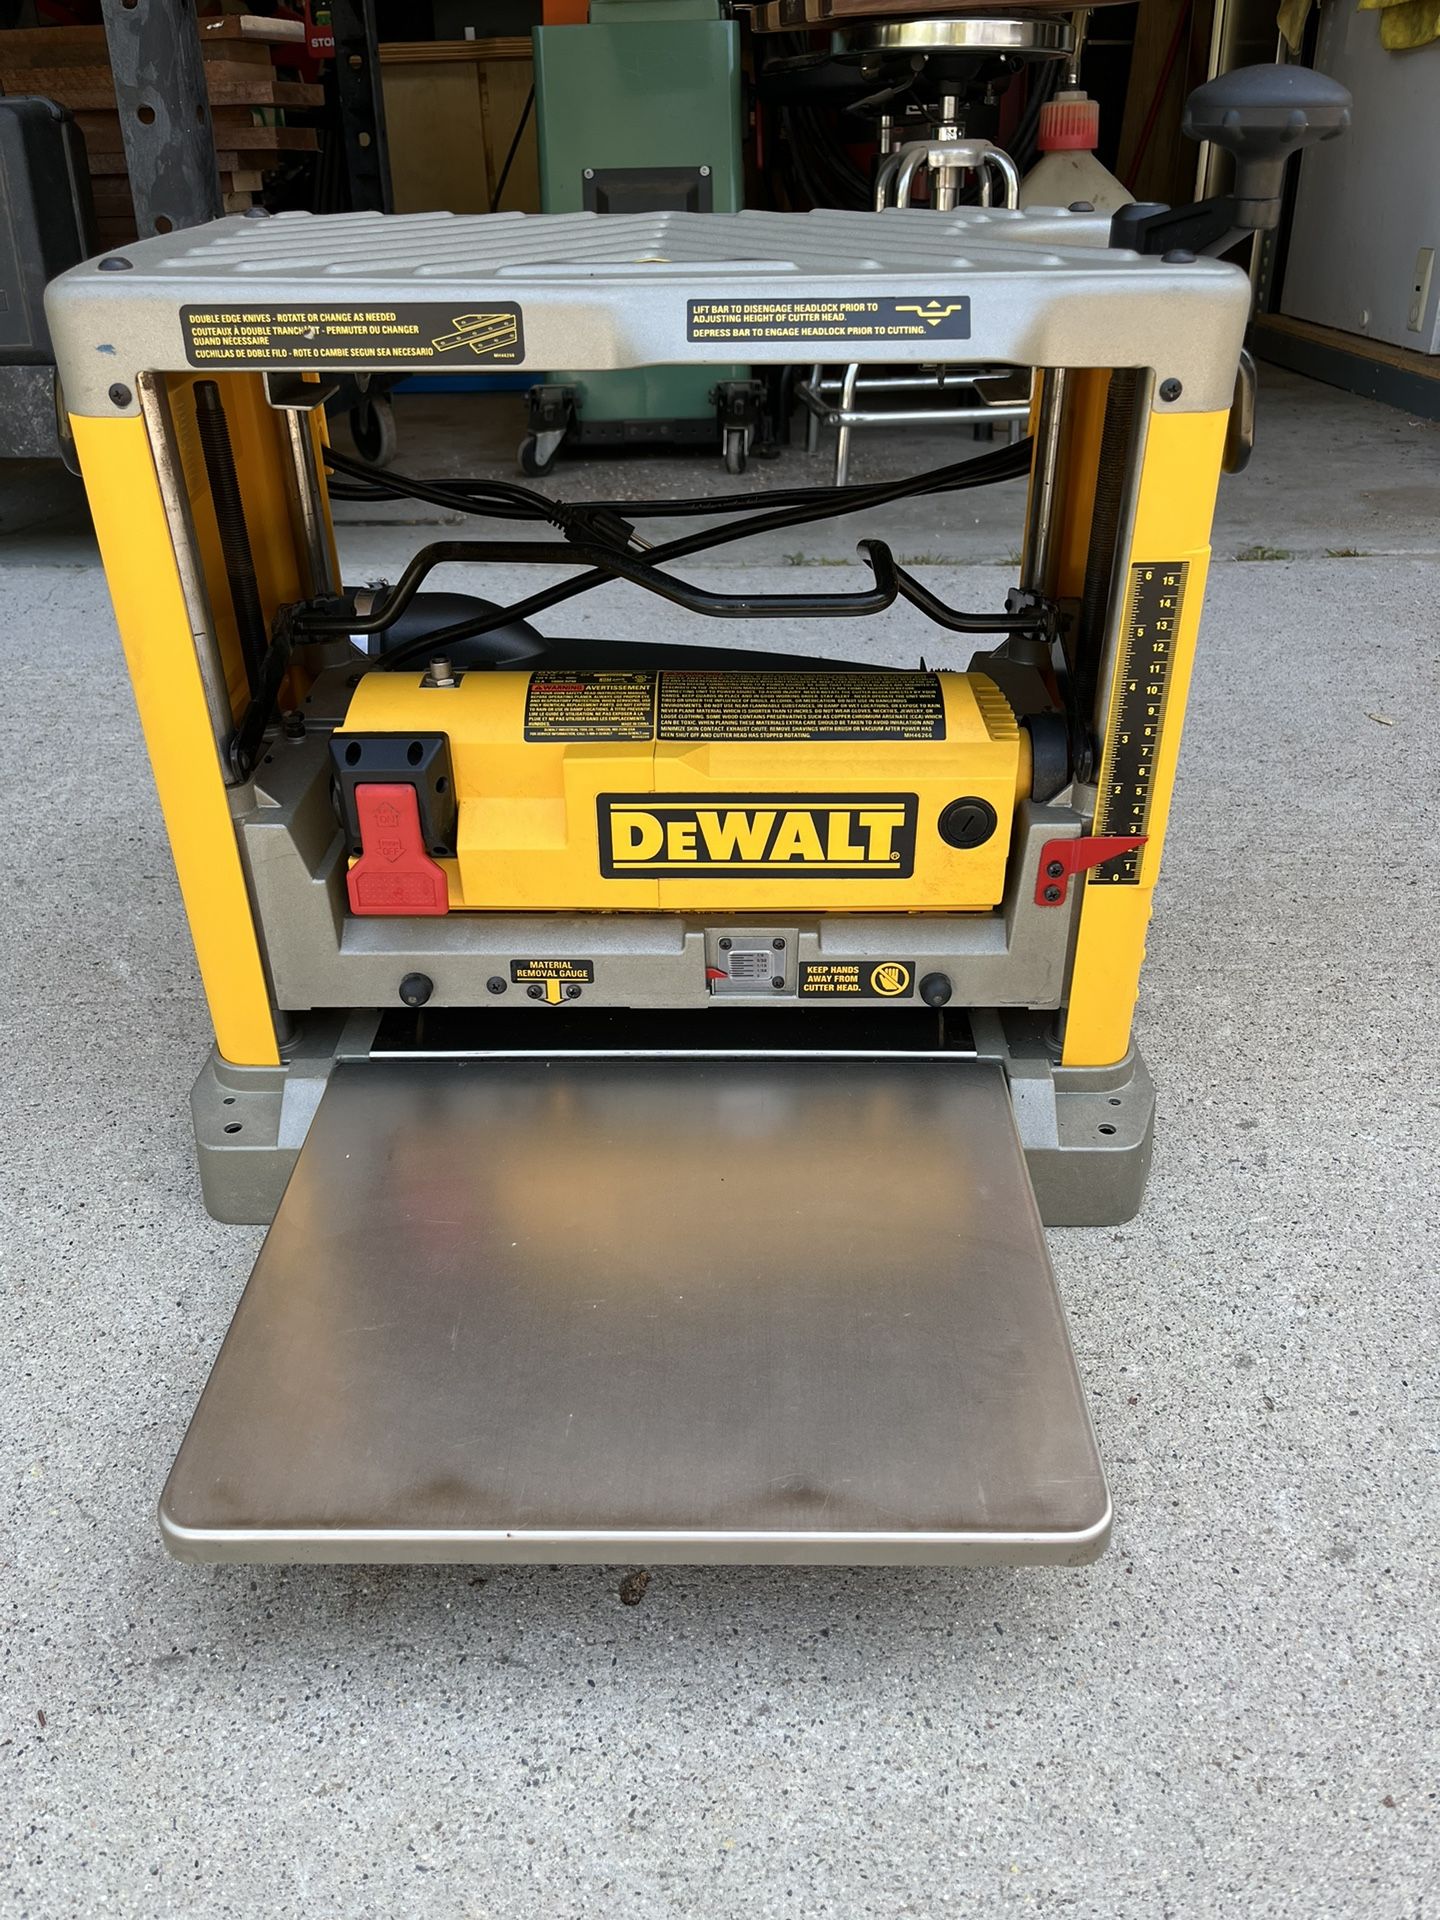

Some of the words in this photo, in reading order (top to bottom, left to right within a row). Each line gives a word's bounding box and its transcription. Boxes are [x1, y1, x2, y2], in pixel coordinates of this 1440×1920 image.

[693, 305, 709, 314] LIFT
[711, 305, 729, 314] BAR
[732, 305, 742, 314] TO
[744, 304, 792, 314] DISENGAGE
[794, 303, 838, 313] HEADLOCK
[840, 303, 865, 312] PRIOR
[868, 303, 879, 312] TO
[189, 314, 219, 324] DOUBLE
[221, 314, 241, 323] EDGE
[242, 314, 271, 323] KNIVES
[277, 313, 305, 323] ROTATE
[307, 313, 318, 322] OR
[320, 313, 351, 322] CHANGE
[353, 313, 364, 322] AS
[365, 312, 397, 322] NEEDED
[693, 314, 741, 324] ADJUSTING
[743, 314, 773, 323] HEIGHT
[776, 314, 785, 322] OF
[788, 313, 820, 322] CUTTER
[821, 313, 847, 321] HEAD.
[191, 326, 232, 336] COUTEAUX
[241, 326, 271, 336] DOUBLE
[326, 326, 368, 335] PERMUTER
[369, 326, 380, 335] OU
[382, 325, 419, 335] CHANGER
[693, 328, 731, 337] DEPRESS
[732, 328, 750, 337] BAR
[753, 328, 763, 336] TO
[765, 327, 799, 336] ENGAGE
[801, 327, 845, 336] HEADLOCK
[847, 326, 873, 335] PRIOR
[875, 326, 886, 335] TO
[887, 326, 926, 335] CUTTING.
[193, 337, 221, 346] QUAND
[195, 349, 234, 358] CUCHILLAS
[236, 349, 245, 358] DE
[246, 349, 270, 358] DOBLE
[272, 348, 287, 358] FILO
[293, 348, 312, 358] ROTE
[313, 348, 319, 357] O
[320, 348, 349, 357] CAMBIE
[377, 348, 391, 357] SEA
[392, 347, 434, 356] NECESARIO
[1145, 571, 1153, 581] 6
[1162, 576, 1174, 586] 15
[1159, 599, 1171, 608] 14
[1156, 621, 1168, 630] 13
[1136, 628, 1144, 638] 5
[1152, 643, 1164, 652] 12
[1149, 665, 1161, 674] 11
[1129, 682, 1137, 692] 4
[1146, 686, 1158, 695] 10
[1148, 707, 1155, 716] 9
[1144, 727, 1152, 736] 8
[1122, 735, 1129, 744] 3
[1142, 748, 1149, 756] 7
[1138, 767, 1146, 776] 6
[1115, 786, 1122, 794] 2
[1136, 787, 1142, 796] 5
[1132, 806, 1140, 815] 4
[1130, 825, 1137, 834] 3
[1125, 863, 1131, 871] 1
[1112, 873, 1120, 882] 0
